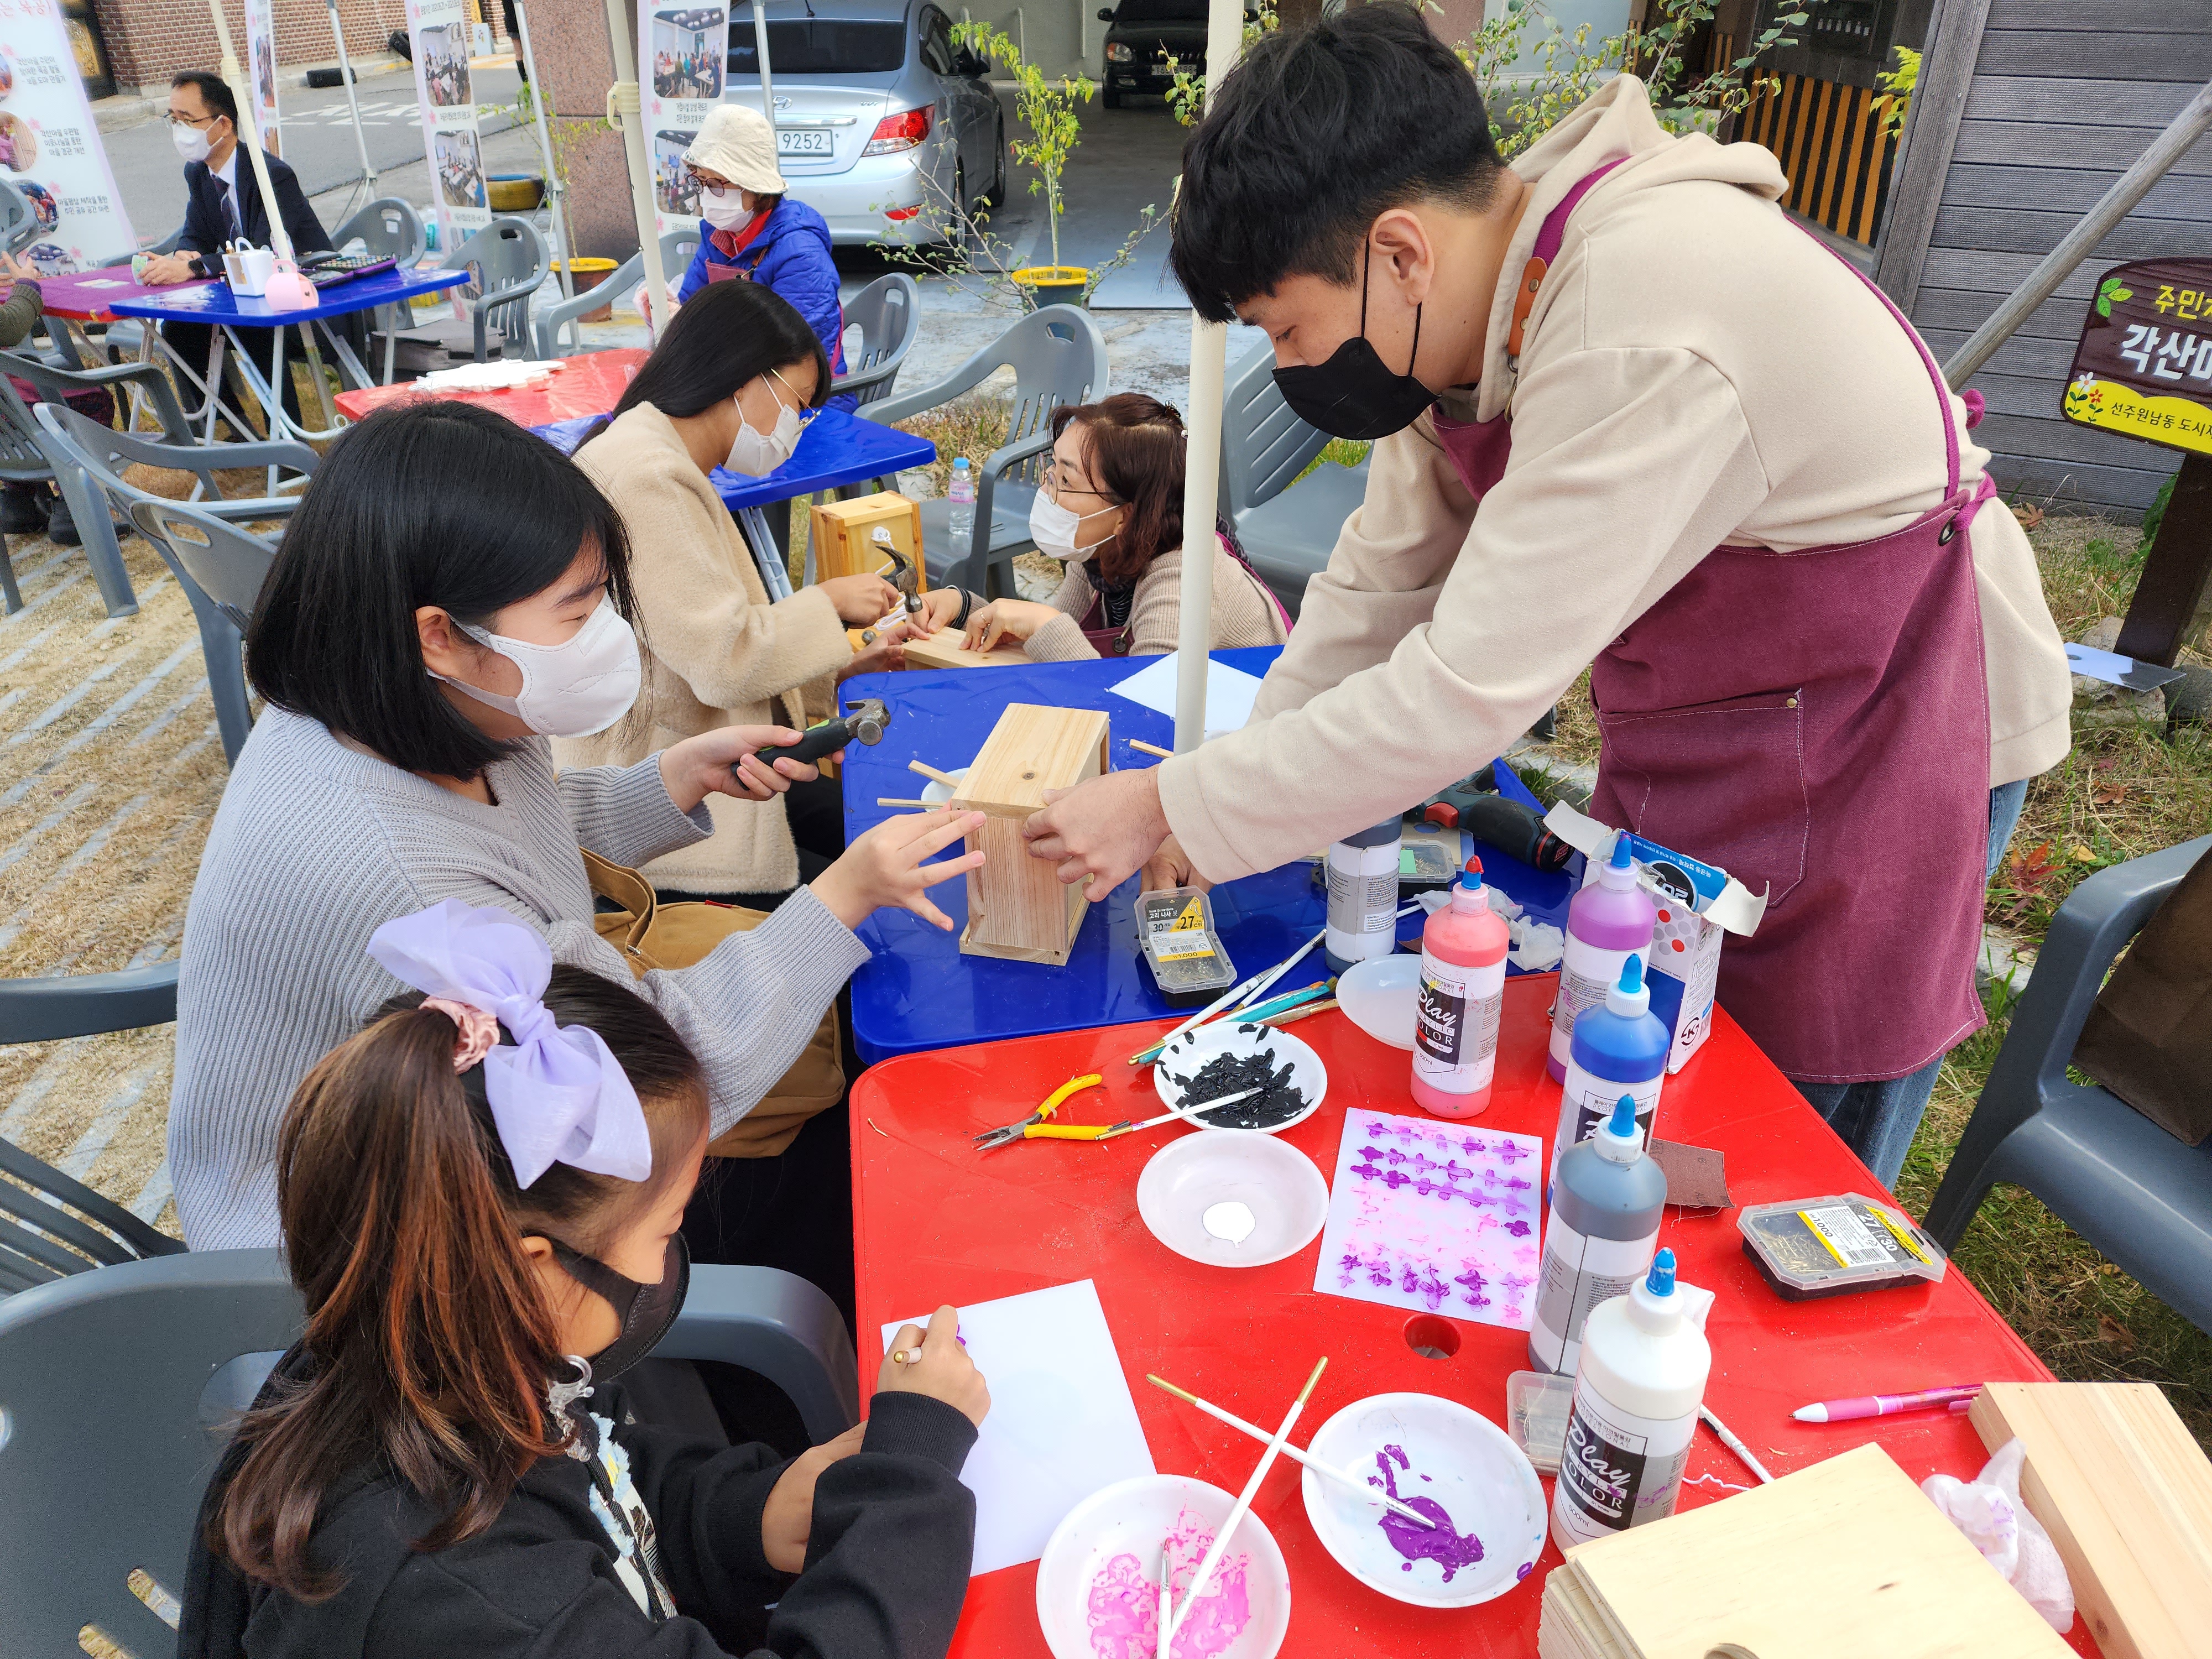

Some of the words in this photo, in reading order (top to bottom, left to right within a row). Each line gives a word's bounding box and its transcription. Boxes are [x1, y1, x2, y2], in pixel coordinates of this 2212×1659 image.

[15, 56, 39, 65] 각산마을
[40, 129, 63, 137] 각산마을
[783, 134, 822, 149] 9252
[2111, 402, 2176, 429] 선주원남동
[1153, 924, 1164, 932] 30
[1418, 984, 1457, 1027] Play
[1418, 1019, 1453, 1046] OLOR
[1419, 1052, 1433, 1066] 500ml
[1859, 1213, 1879, 1231] 27
[1873, 1211, 1928, 1260] HOMEGEAR
[1881, 1239, 1898, 1251] 30
[1568, 1416, 1631, 1489] Play
[1568, 1504, 1589, 1527] 500ml
